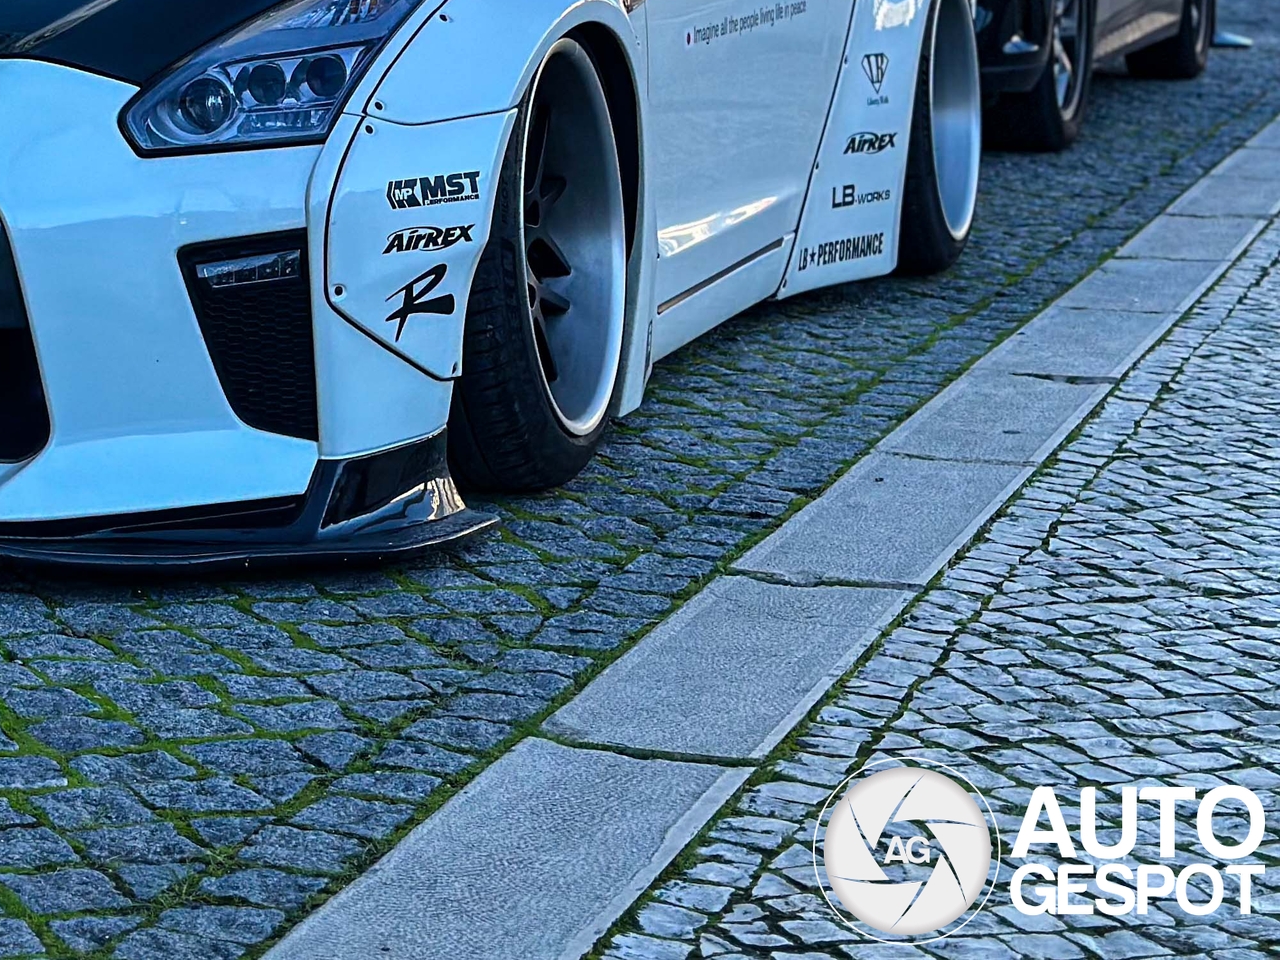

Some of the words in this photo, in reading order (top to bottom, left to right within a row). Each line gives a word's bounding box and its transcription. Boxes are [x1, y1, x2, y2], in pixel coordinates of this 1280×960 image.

[693, 25, 720, 44] Imagine
[720, 17, 728, 36] all
[728, 15, 739, 34] the
[739, 9, 759, 36] people
[798, 248, 808, 271] LB
[817, 233, 884, 266] PERFORMANCE
